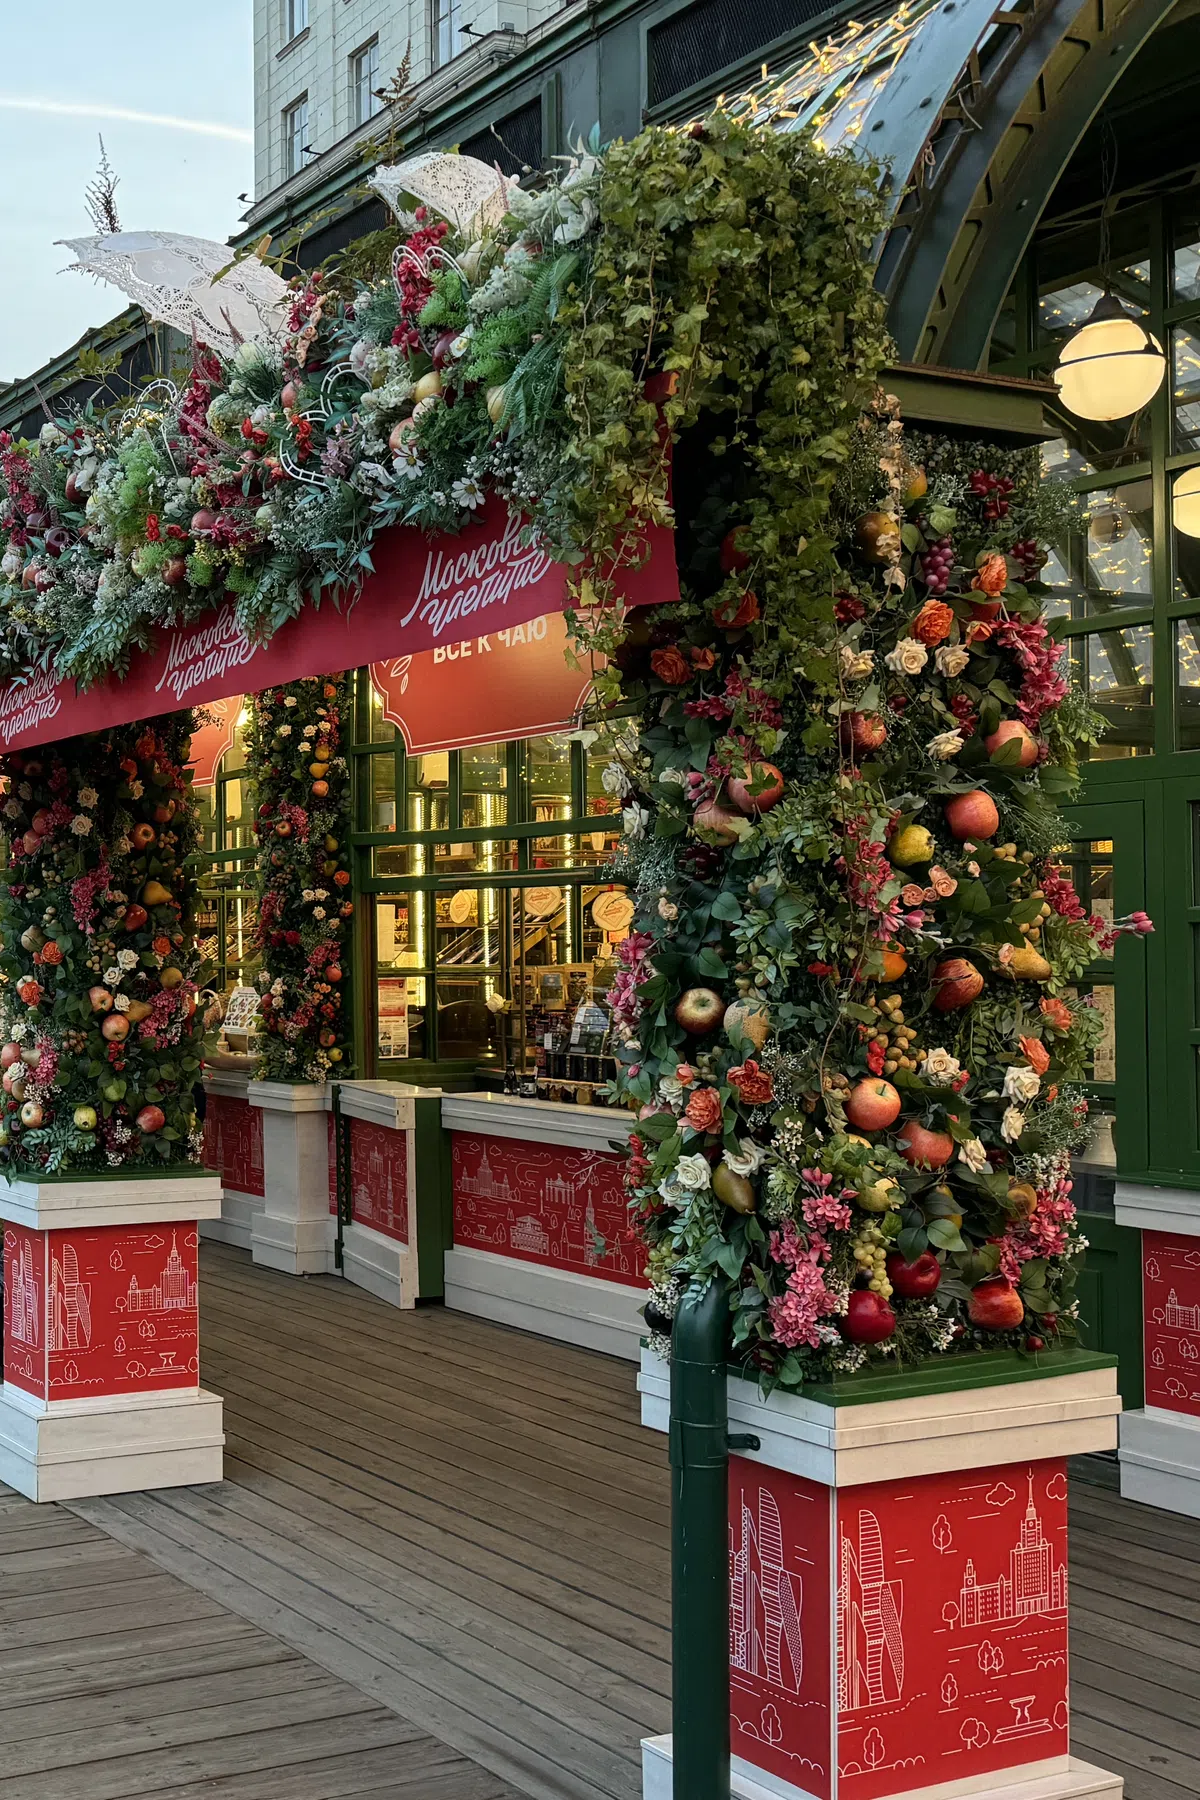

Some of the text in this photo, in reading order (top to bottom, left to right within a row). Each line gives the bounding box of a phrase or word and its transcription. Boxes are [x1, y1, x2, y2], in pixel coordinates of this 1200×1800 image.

[400, 510, 541, 628] Московс
[419, 550, 552, 637] чаепитие
[155, 603, 244, 692] Московск
[167, 632, 259, 701] чаепитие
[497, 616, 547, 648] ЧАЮ
